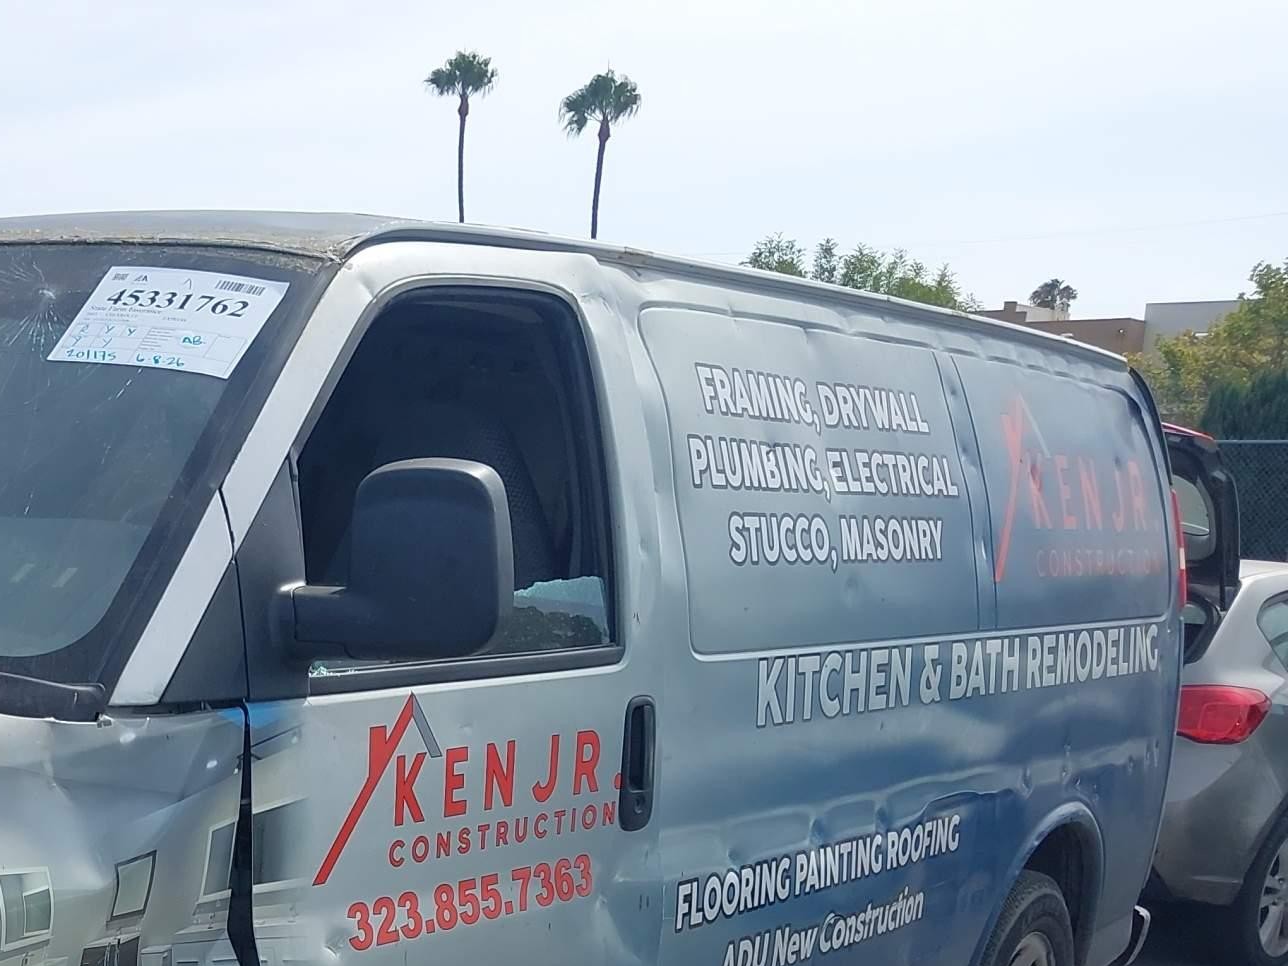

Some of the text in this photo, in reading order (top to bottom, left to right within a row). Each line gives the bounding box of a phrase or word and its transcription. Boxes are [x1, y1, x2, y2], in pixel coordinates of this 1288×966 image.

[106, 288, 249, 318] 45331762
[695, 363, 930, 435] FRAMING, DRYWALL
[688, 435, 959, 501] PLUMBING, ELECTRICAL
[1024, 451, 1103, 530] KEN
[729, 511, 944, 571] STUCCO, MASONRY
[1035, 549, 1162, 577] CONSTRUCTION
[756, 624, 1159, 727] KITCHEN & BATH REMODELING
[394, 729, 624, 828] KEN JR.
[388, 800, 617, 867] CONSTRUCTION
[346, 853, 593, 952] 323.855.7363
[675, 814, 961, 933] FLOORING PAINTING ROOFING
[820, 886, 925, 954] Construction
